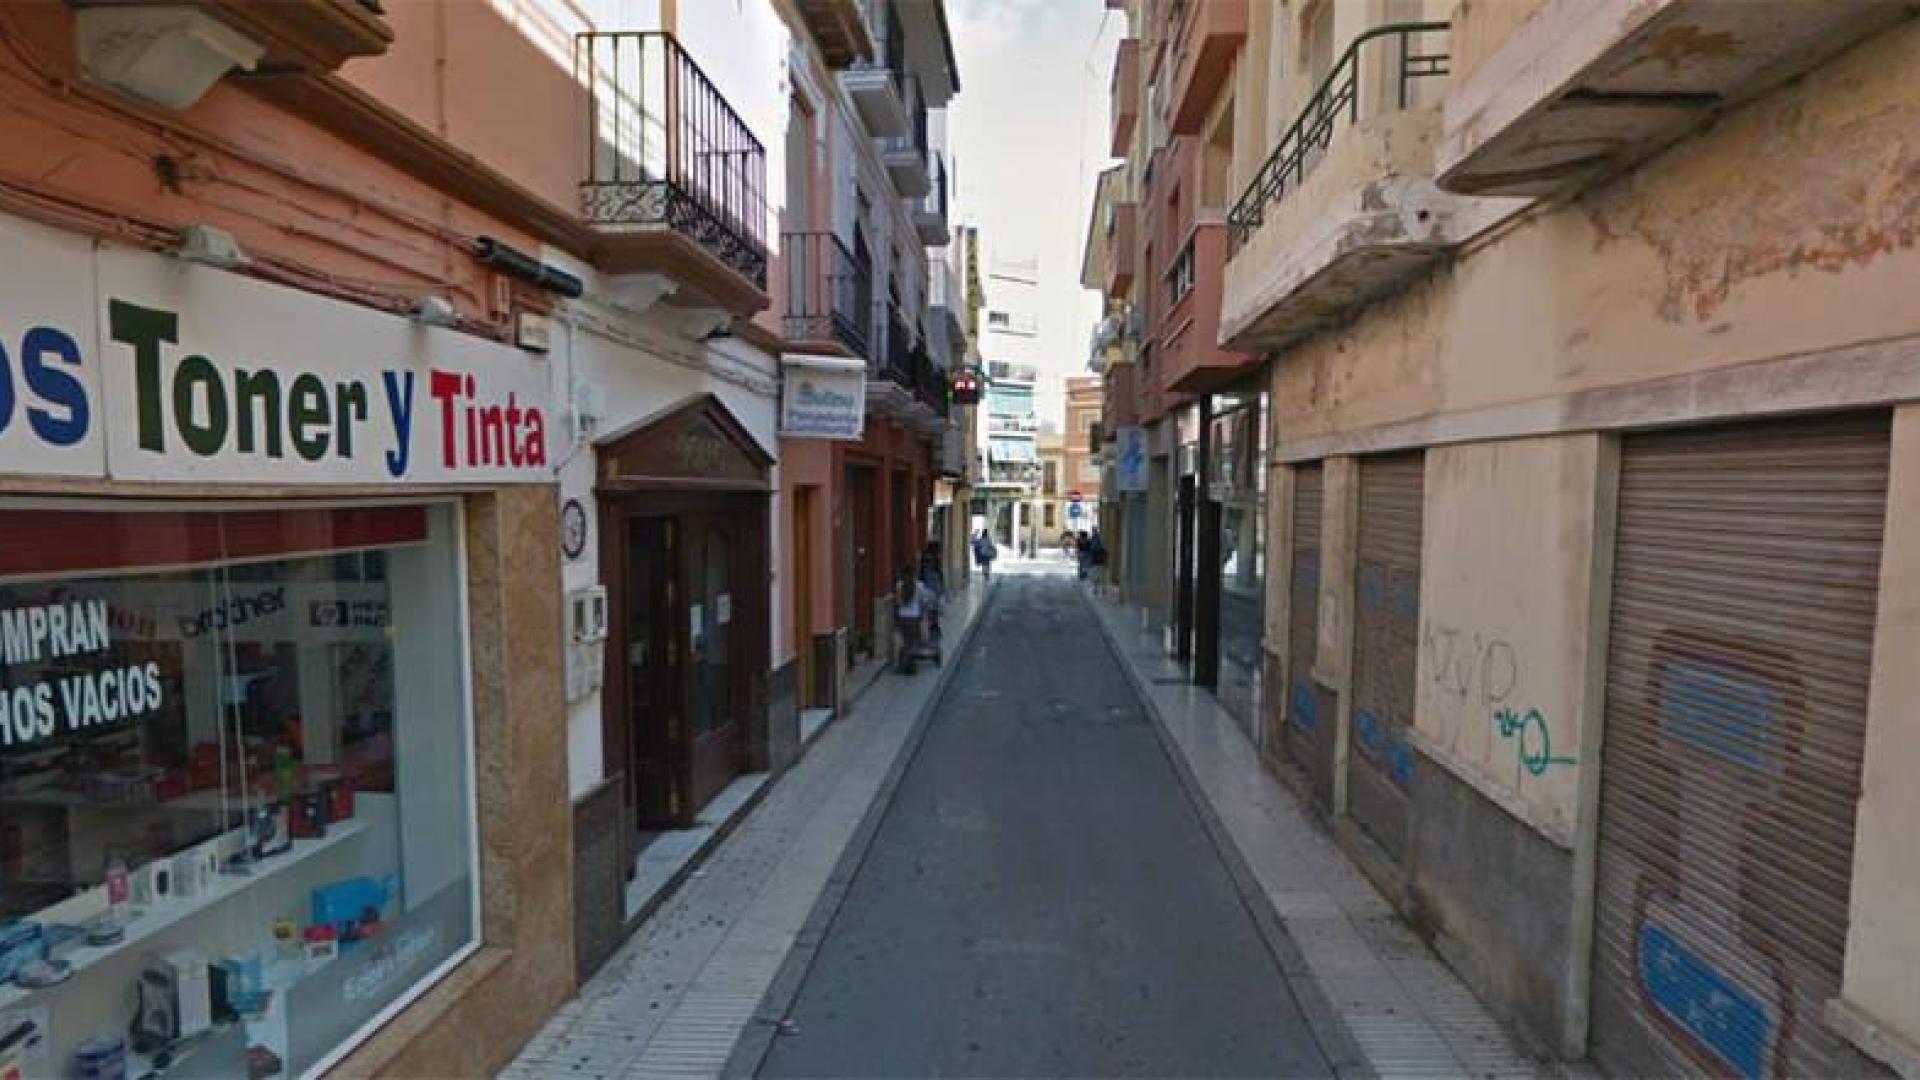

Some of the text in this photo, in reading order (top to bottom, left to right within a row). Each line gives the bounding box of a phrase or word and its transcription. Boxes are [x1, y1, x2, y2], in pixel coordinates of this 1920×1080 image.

[109, 299, 366, 460] Toner
[431, 369, 546, 469] Tinta
[0, 600, 109, 664] MPRAN
[60, 660, 162, 730] VACIOS
